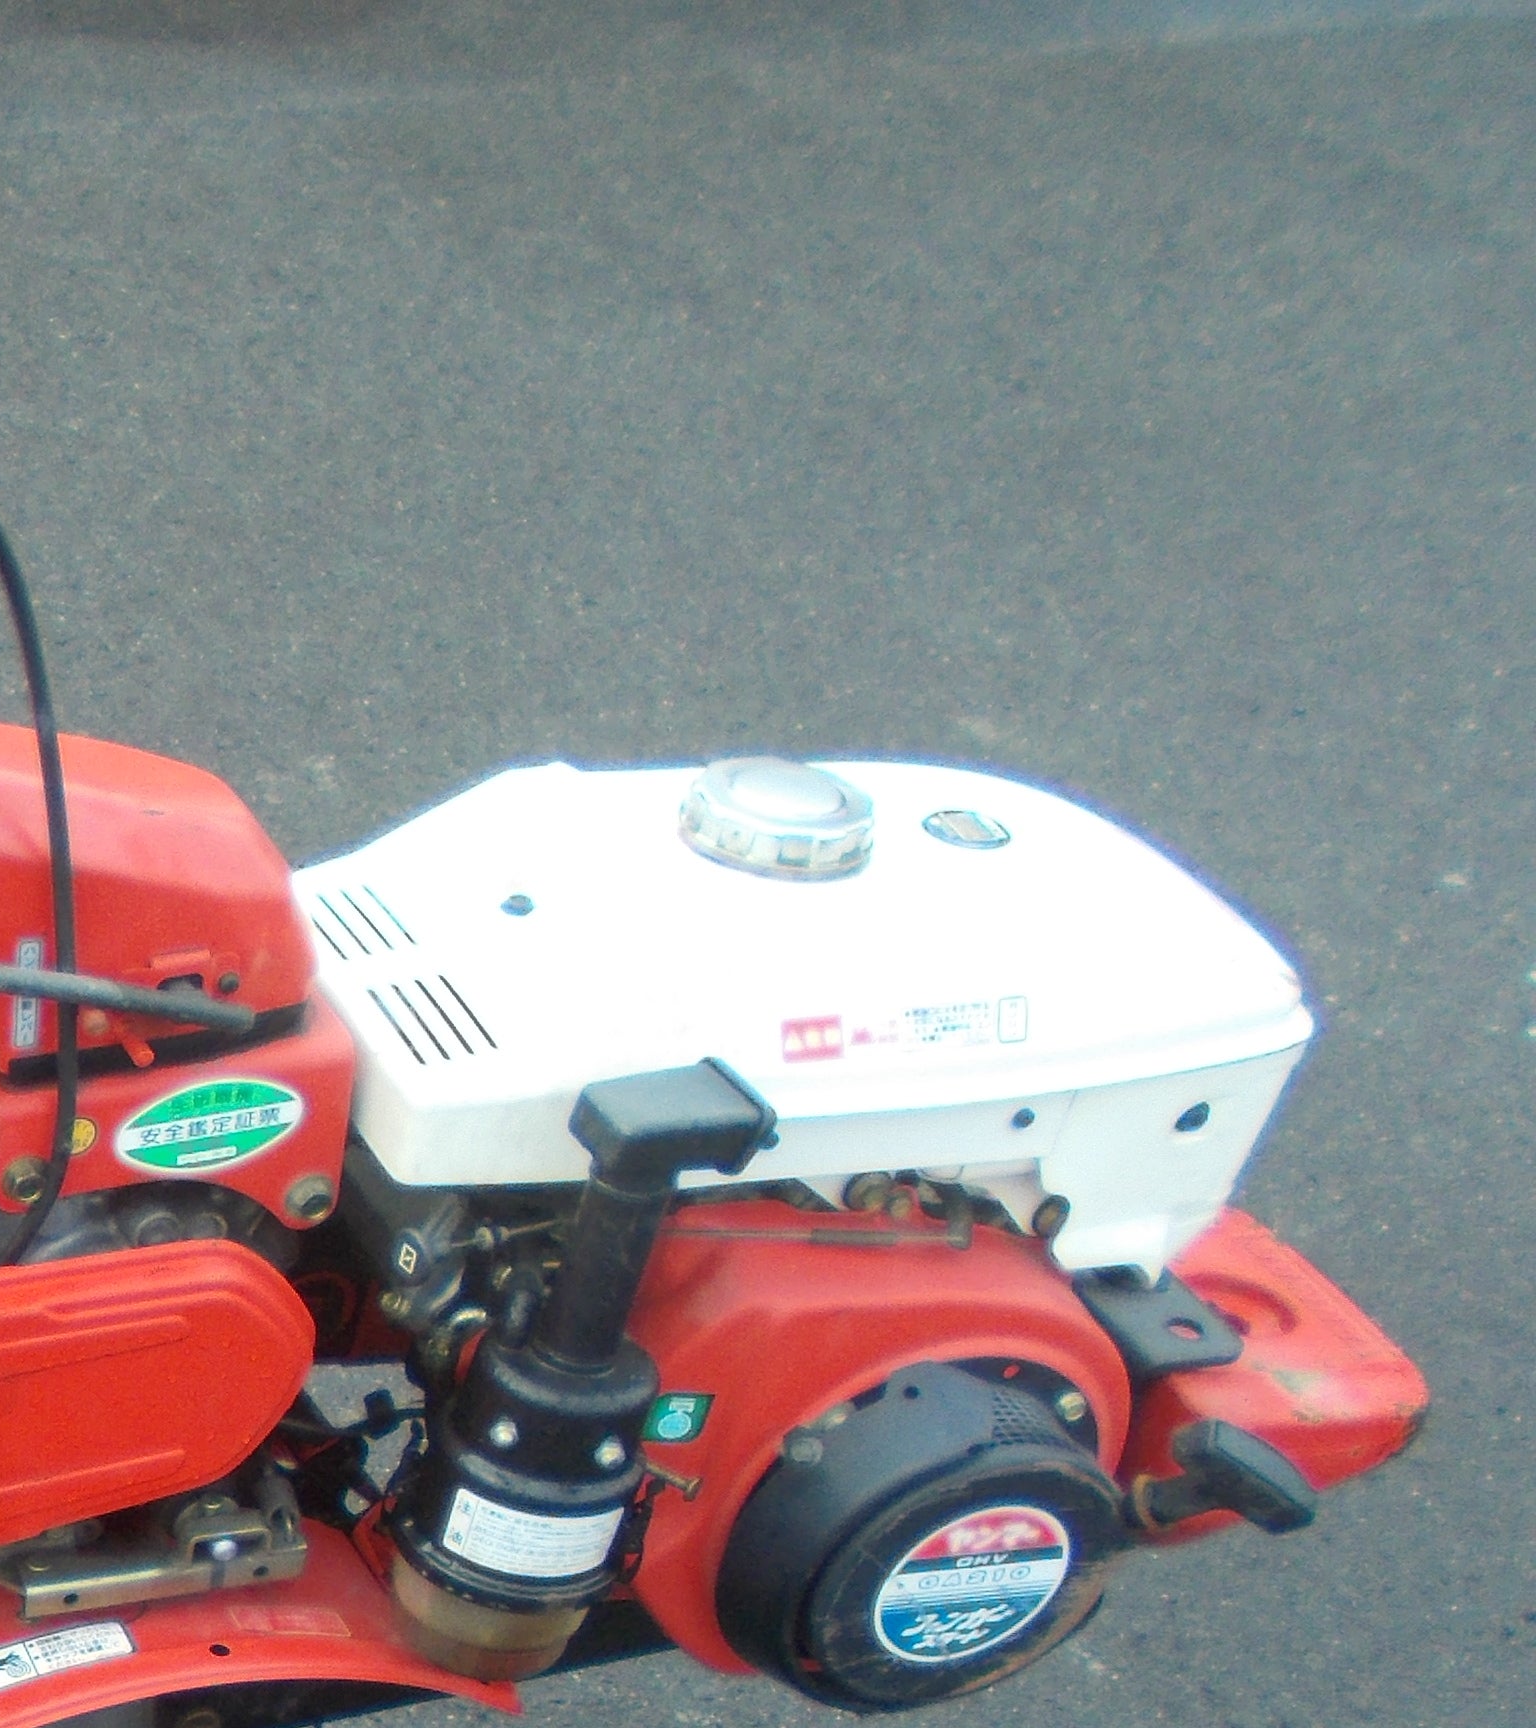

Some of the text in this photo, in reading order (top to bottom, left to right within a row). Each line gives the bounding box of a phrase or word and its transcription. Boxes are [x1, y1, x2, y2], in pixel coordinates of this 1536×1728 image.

[140, 1107, 281, 1145] 安全鑑定証票
